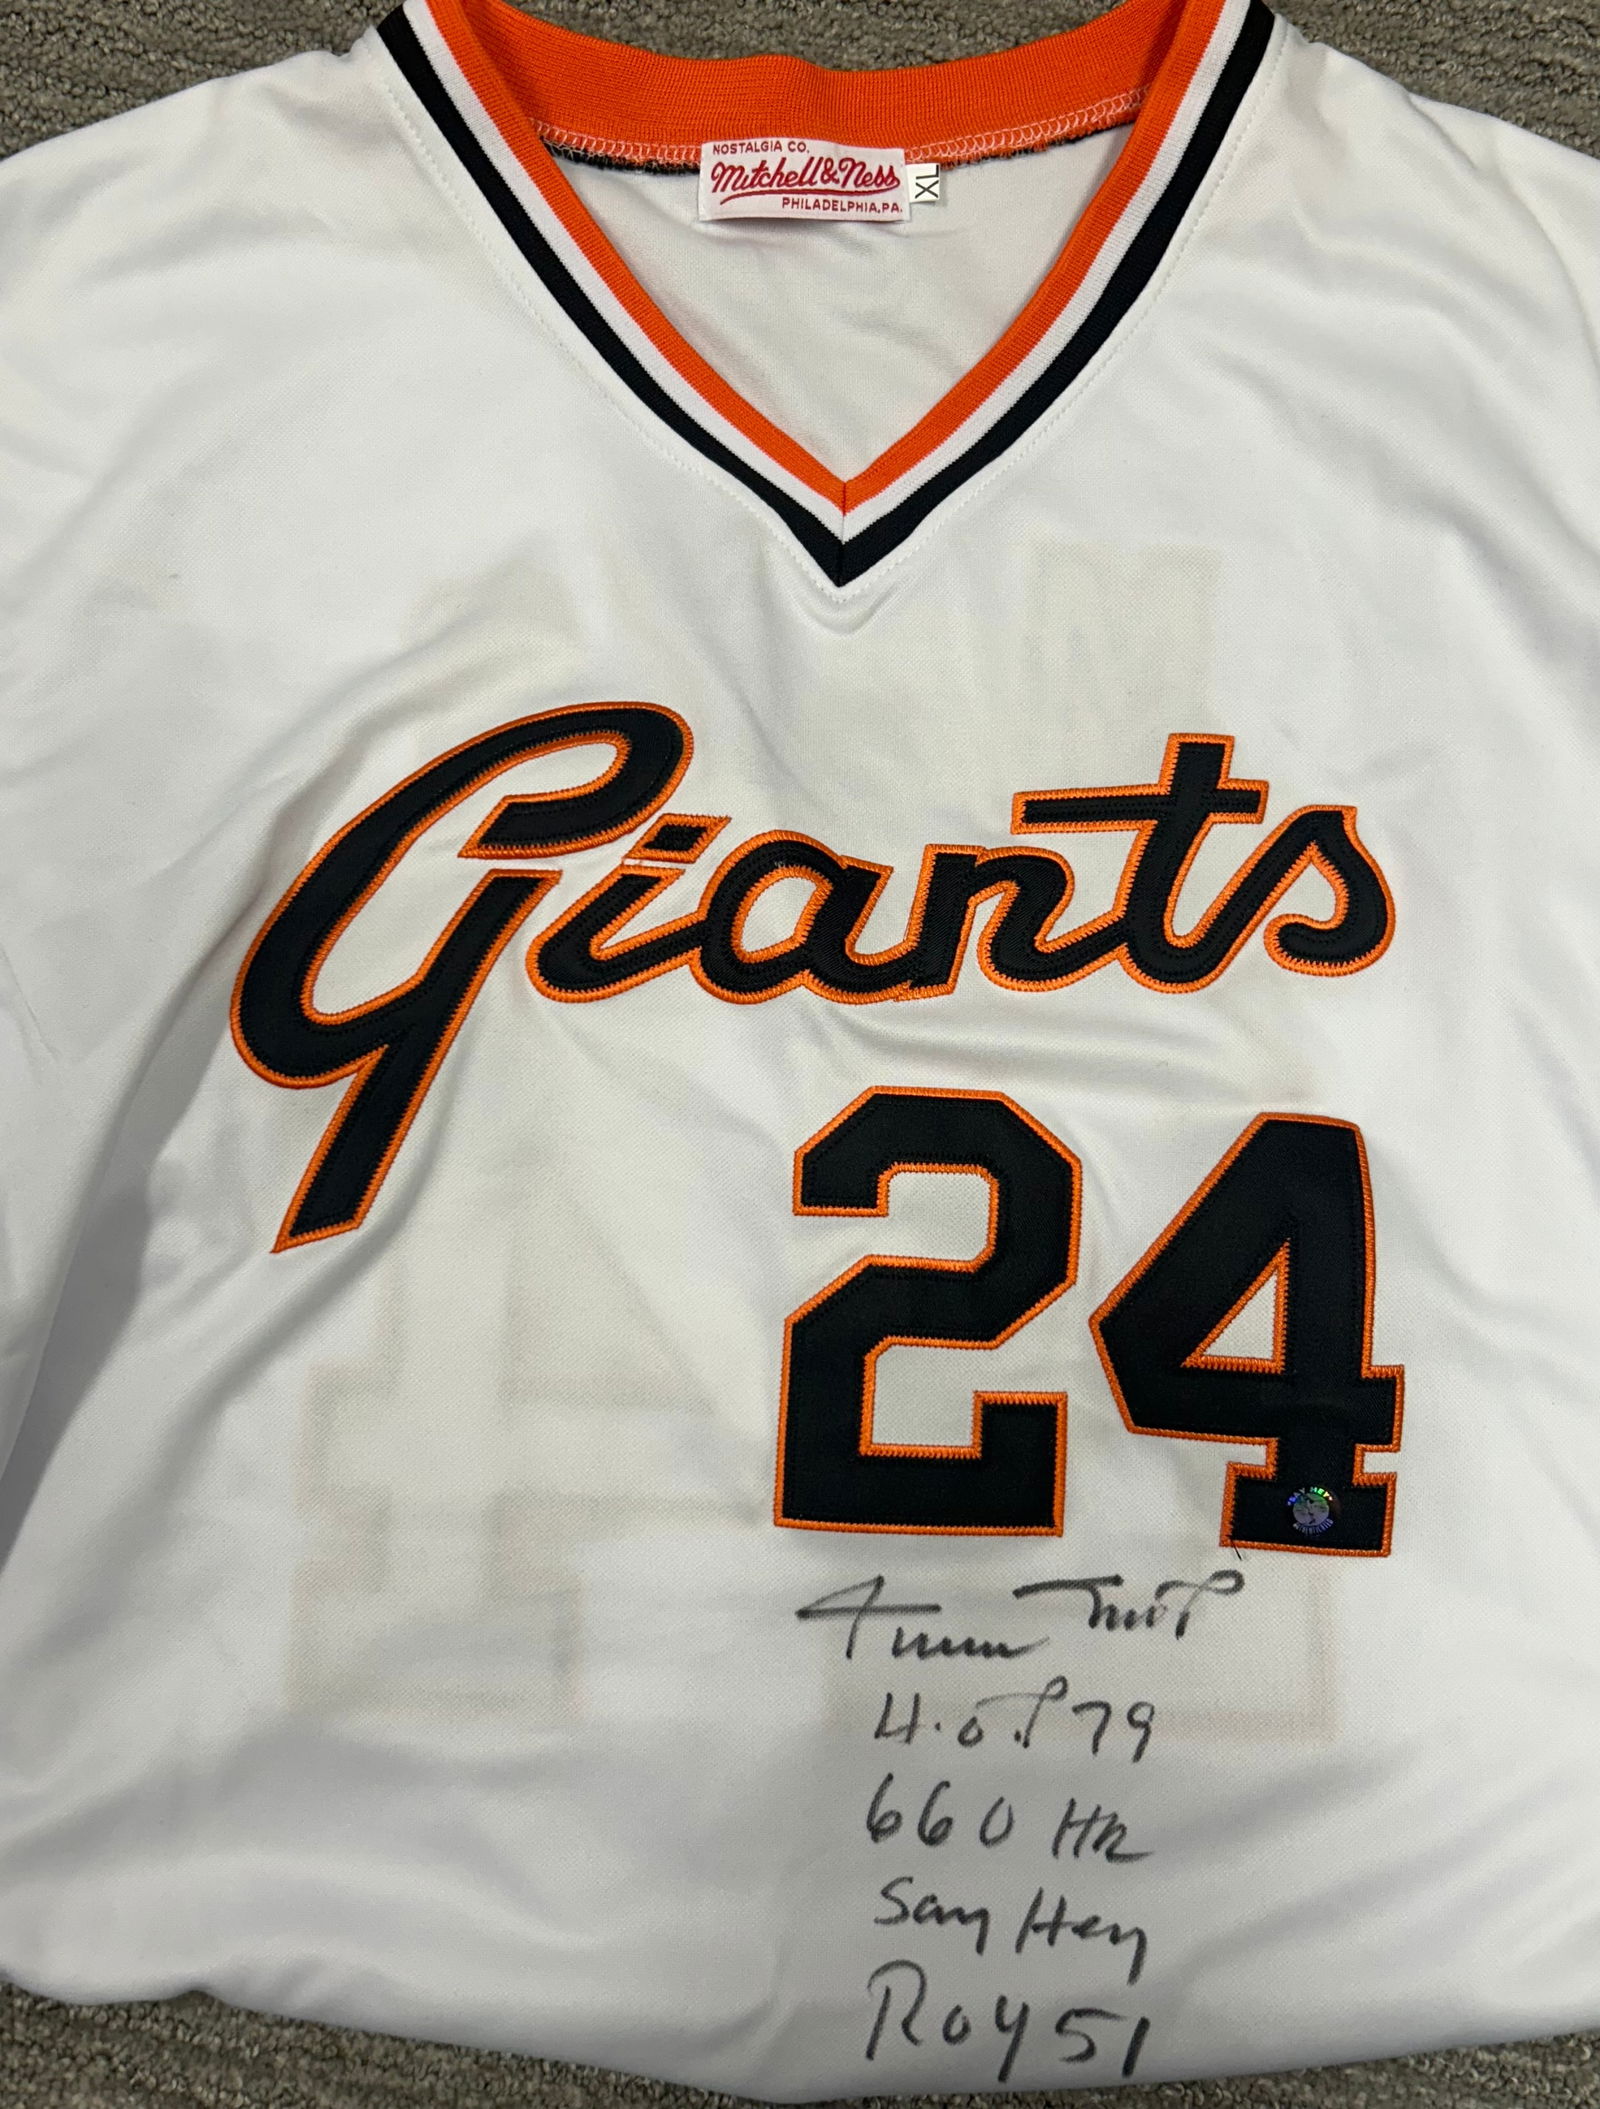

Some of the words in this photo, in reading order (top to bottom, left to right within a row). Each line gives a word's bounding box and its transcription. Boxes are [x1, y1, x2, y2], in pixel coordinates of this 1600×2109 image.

[712, 141, 783, 155] NOSTALGIA
[914, 164, 939, 199] XL
[231, 701, 1396, 1252] Giants
[774, 1086, 1405, 1557] 24
[1072, 1701, 1155, 1763] 79
[866, 1772, 1014, 1847] 660
[1051, 1797, 1154, 1863] HR
[1014, 1886, 1148, 1986] Hey
[1055, 2007, 1151, 2079] 51
